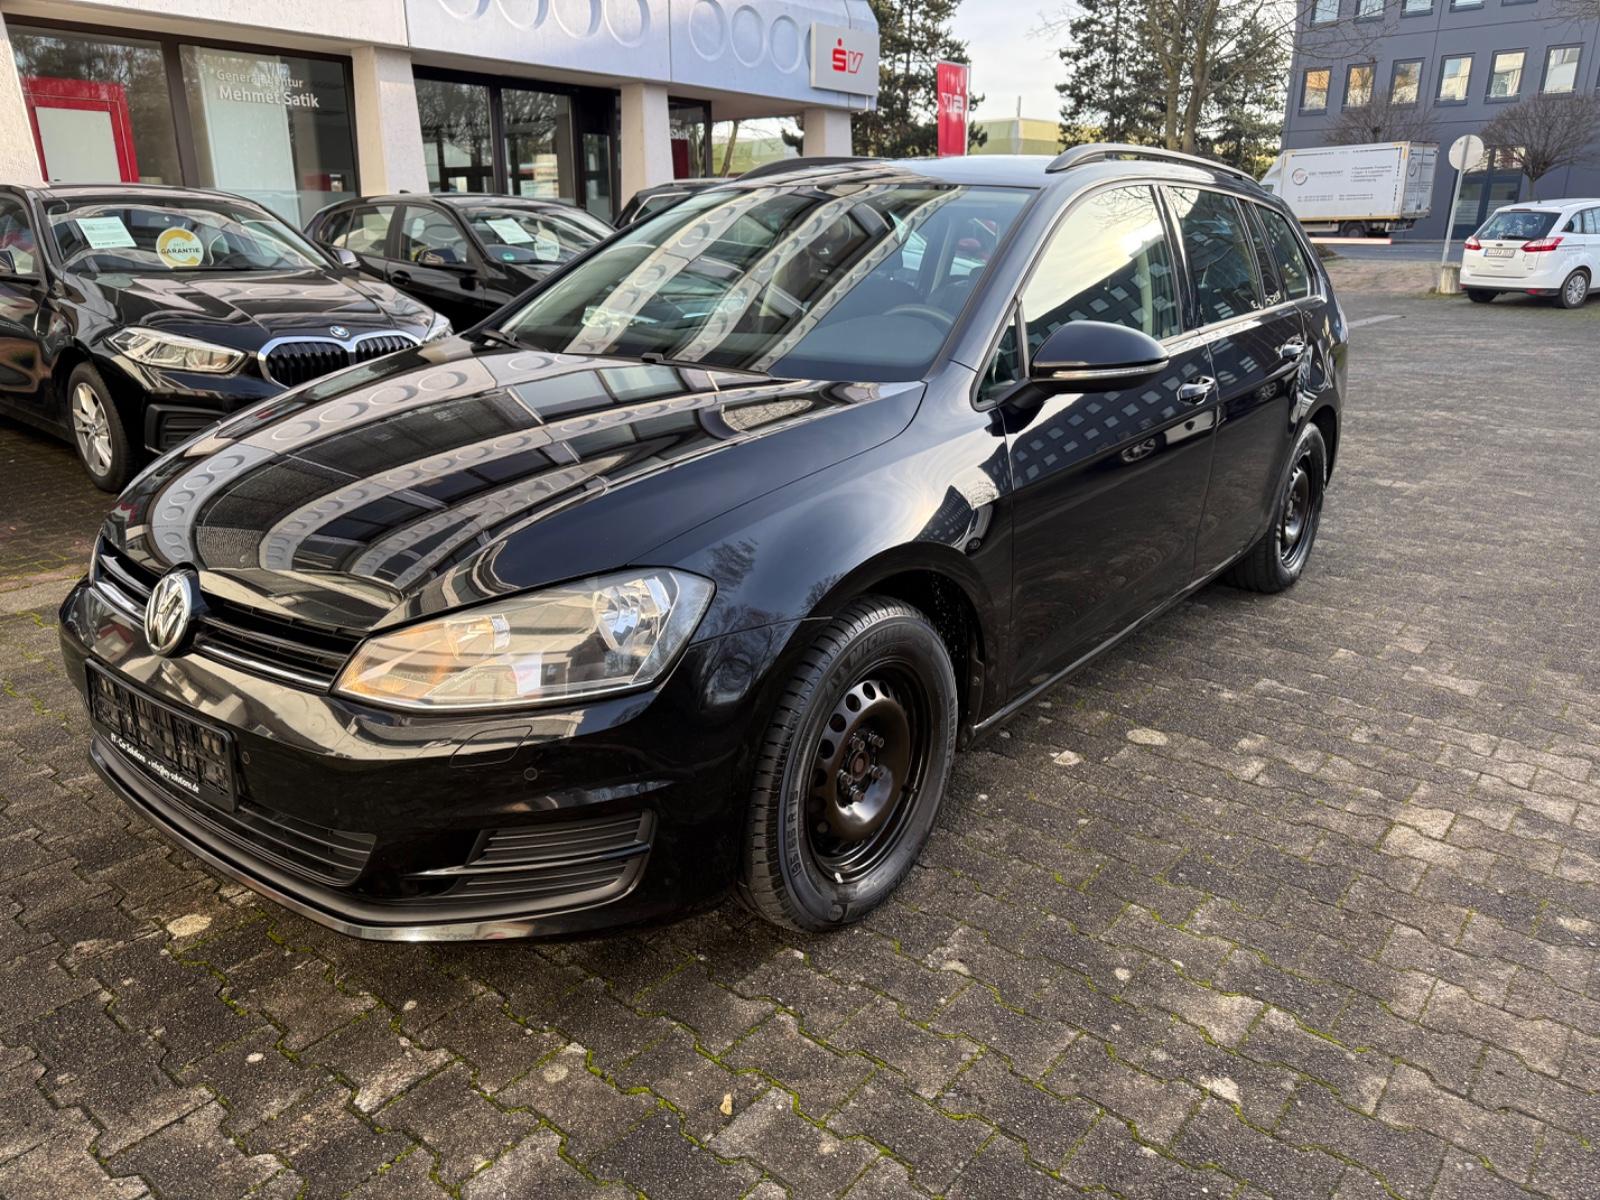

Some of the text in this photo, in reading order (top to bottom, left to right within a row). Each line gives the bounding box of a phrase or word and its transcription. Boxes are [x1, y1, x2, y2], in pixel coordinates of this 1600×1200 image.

[219, 85, 320, 108] Mehmet Satik
[161, 247, 201, 255] GARANTIE
